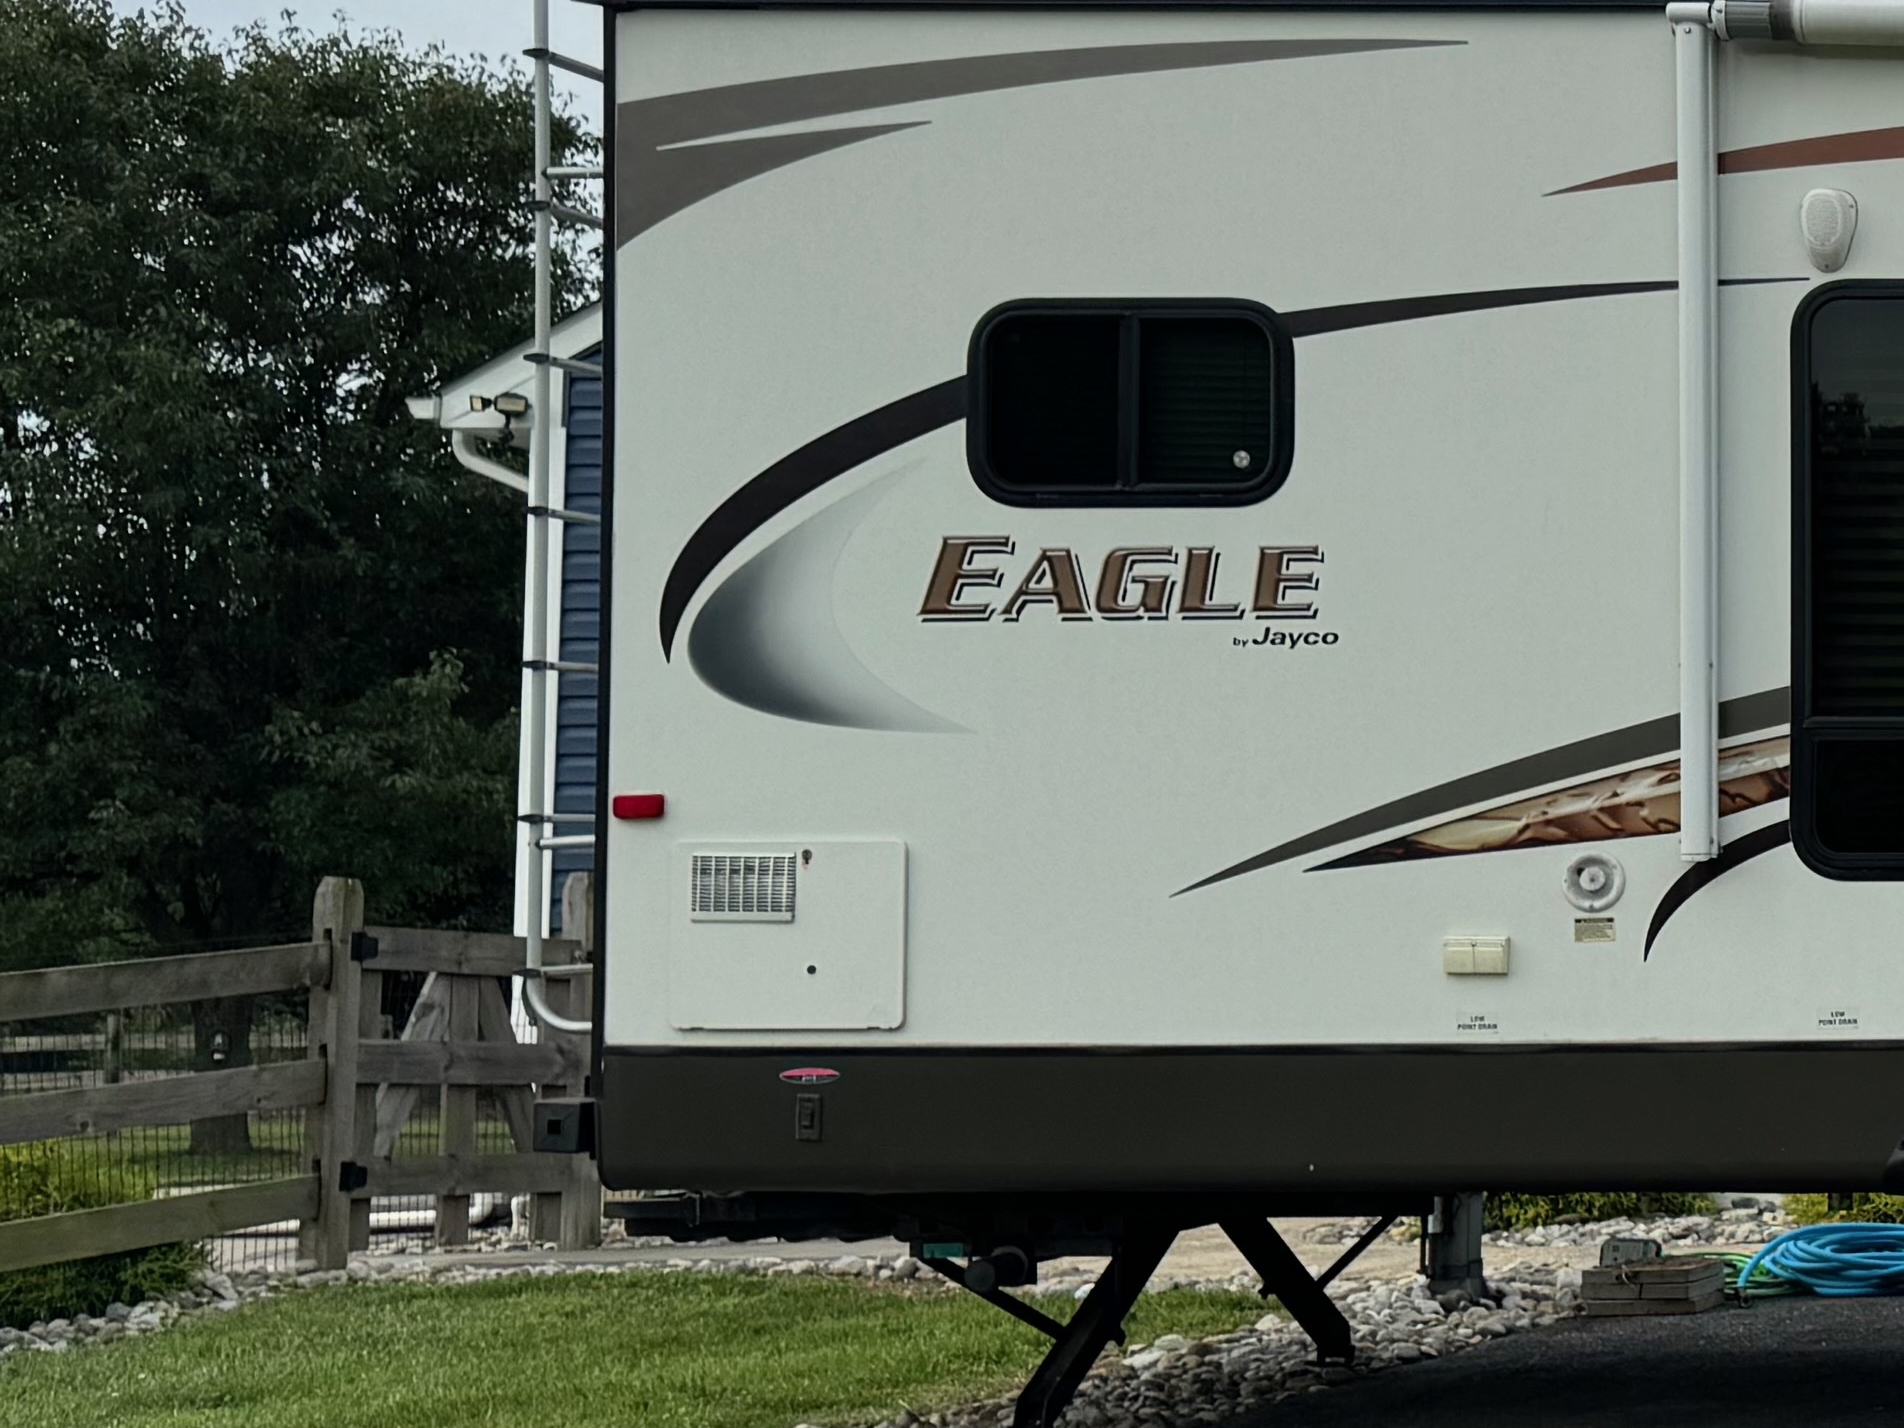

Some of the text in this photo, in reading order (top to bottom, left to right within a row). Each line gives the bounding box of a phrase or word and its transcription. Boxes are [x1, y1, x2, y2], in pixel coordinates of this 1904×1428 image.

[917, 535, 1324, 622] EAGLE
[1233, 627, 1339, 649] by Jayco
